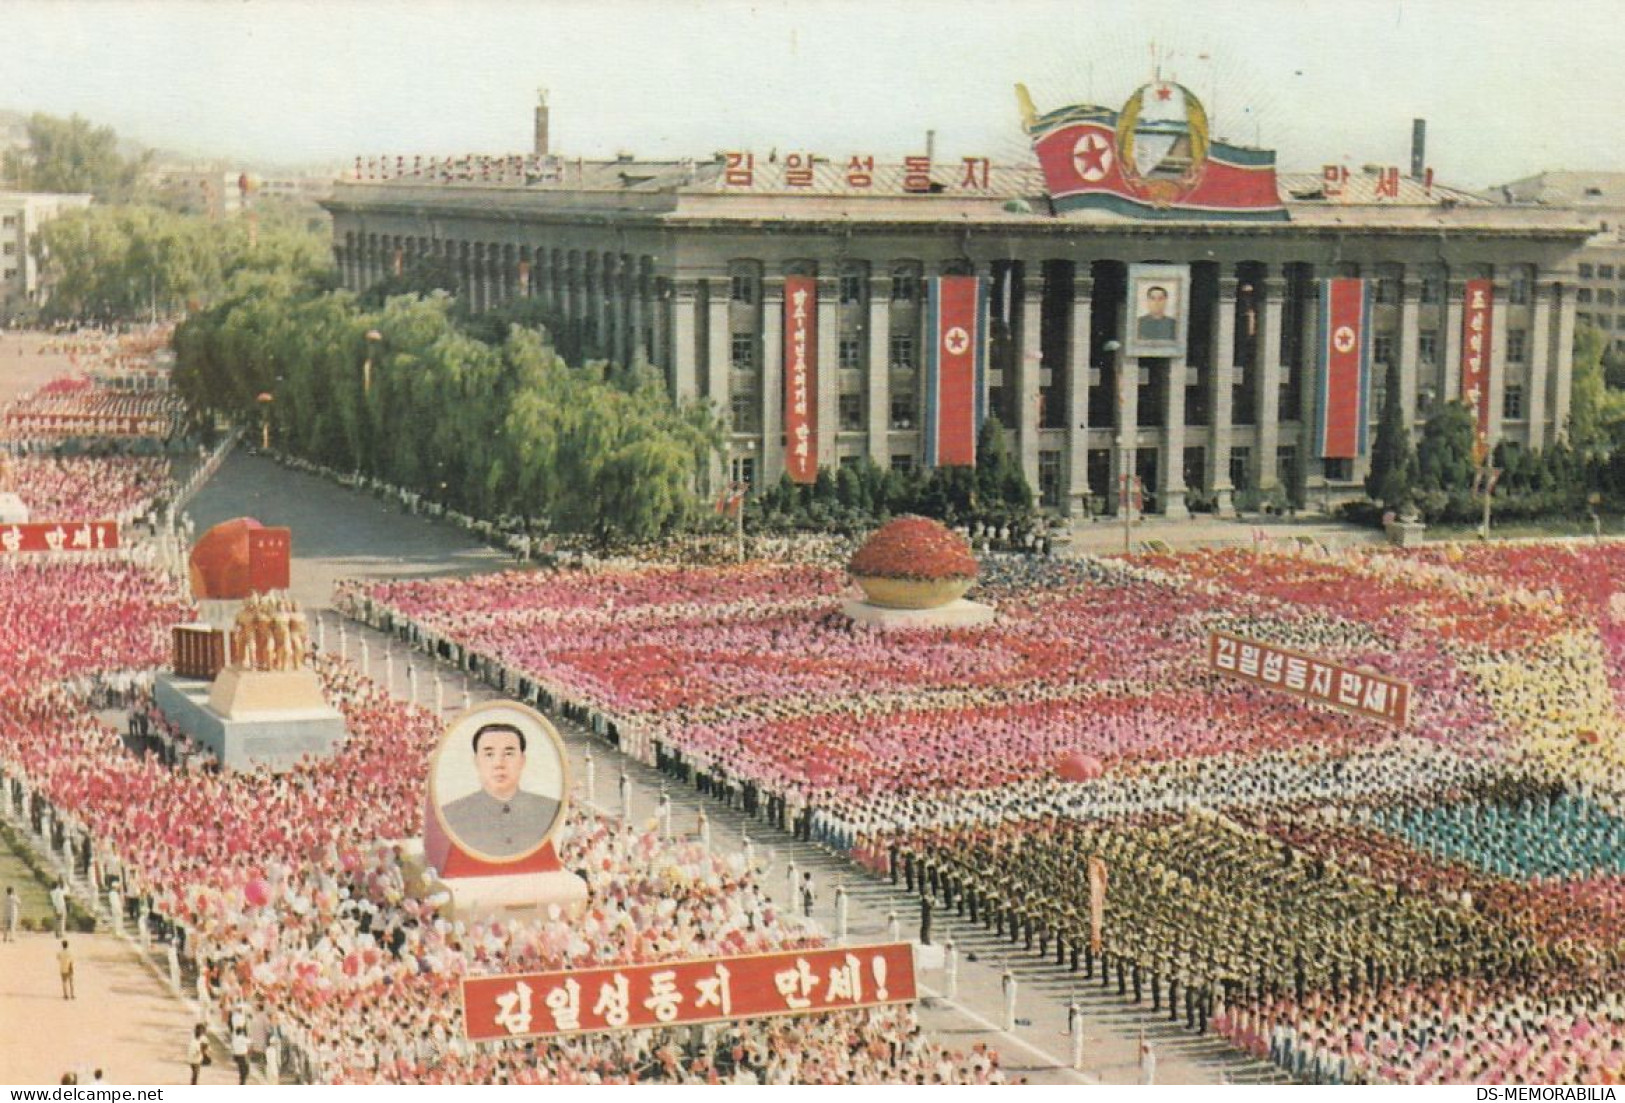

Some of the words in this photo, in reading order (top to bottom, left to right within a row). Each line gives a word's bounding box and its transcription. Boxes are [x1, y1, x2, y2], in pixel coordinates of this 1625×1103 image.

[726, 153, 989, 190] 김일성동지
[1323, 165, 1433, 198] 만세!
[45, 524, 106, 551] 만세!
[1217, 637, 1333, 696] 김일성동지
[1340, 671, 1398, 717] 만세!
[495, 964, 732, 1033] 김일성동지
[774, 953, 890, 1008] 만세!
